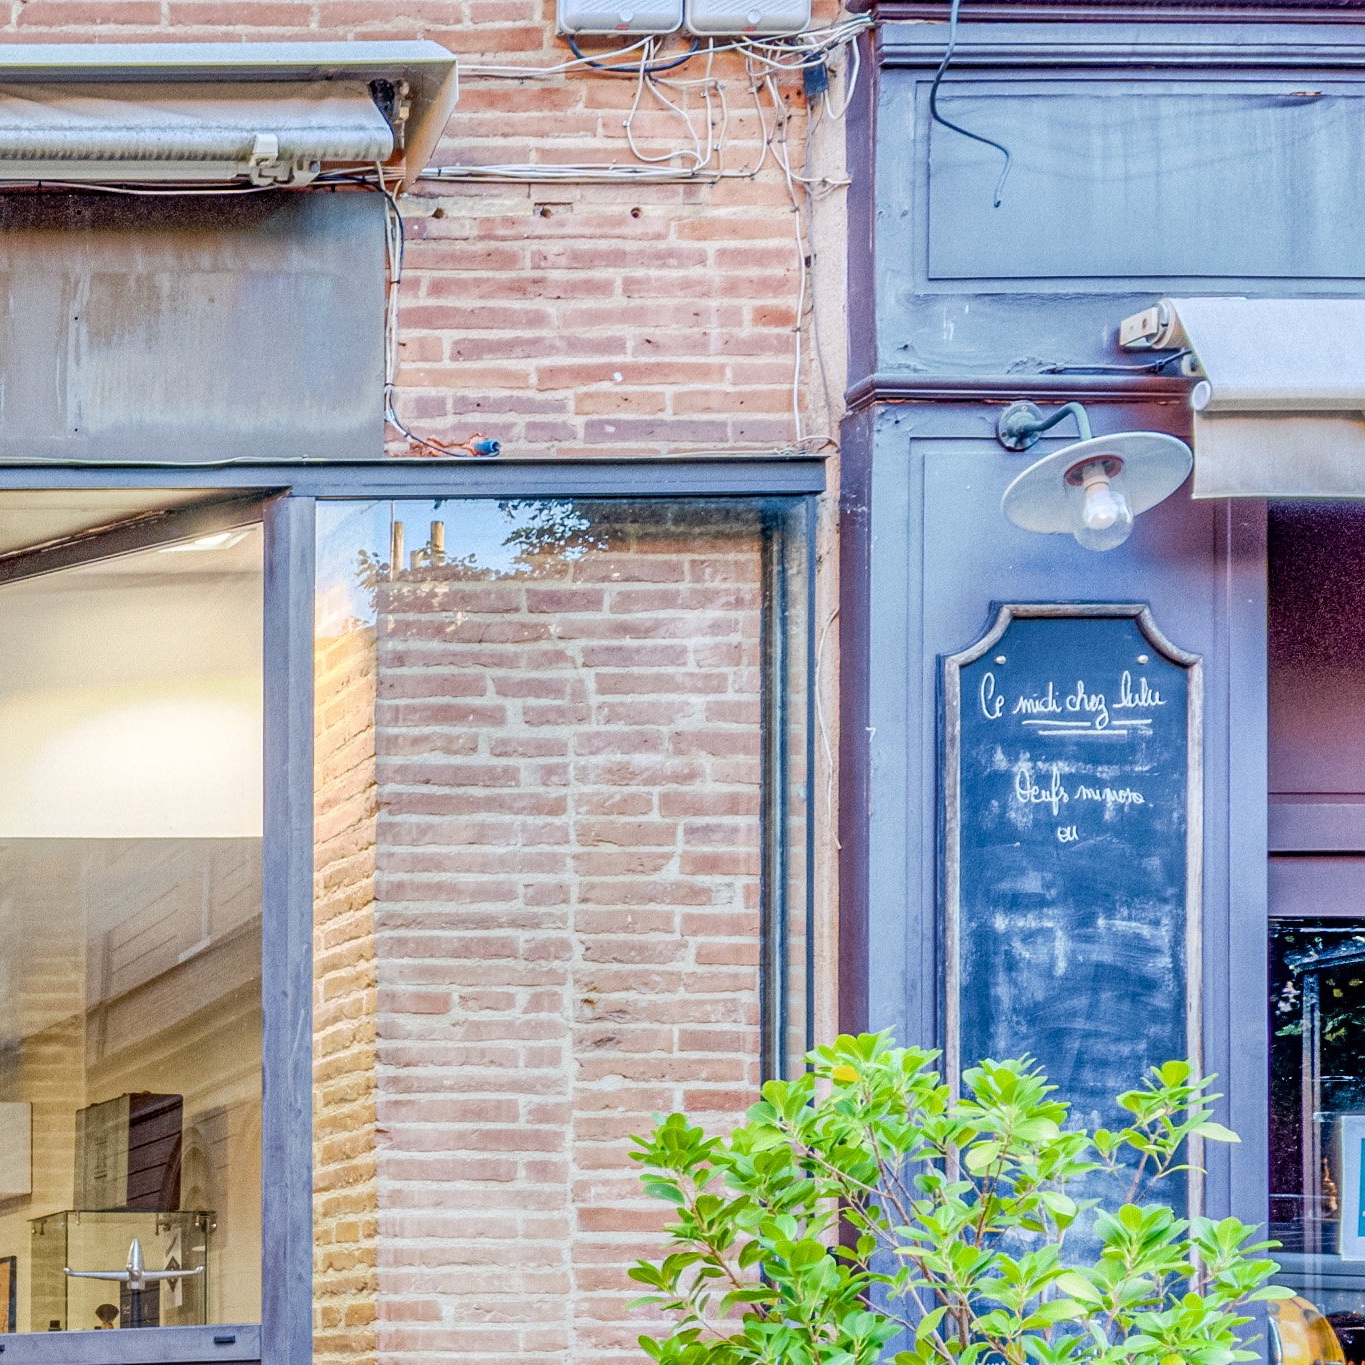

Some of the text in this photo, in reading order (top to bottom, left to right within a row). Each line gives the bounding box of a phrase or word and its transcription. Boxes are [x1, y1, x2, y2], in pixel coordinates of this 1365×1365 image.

[1013, 681, 1062, 714] midi
[1066, 680, 1109, 729] chez
[1057, 825, 1079, 842] ou
